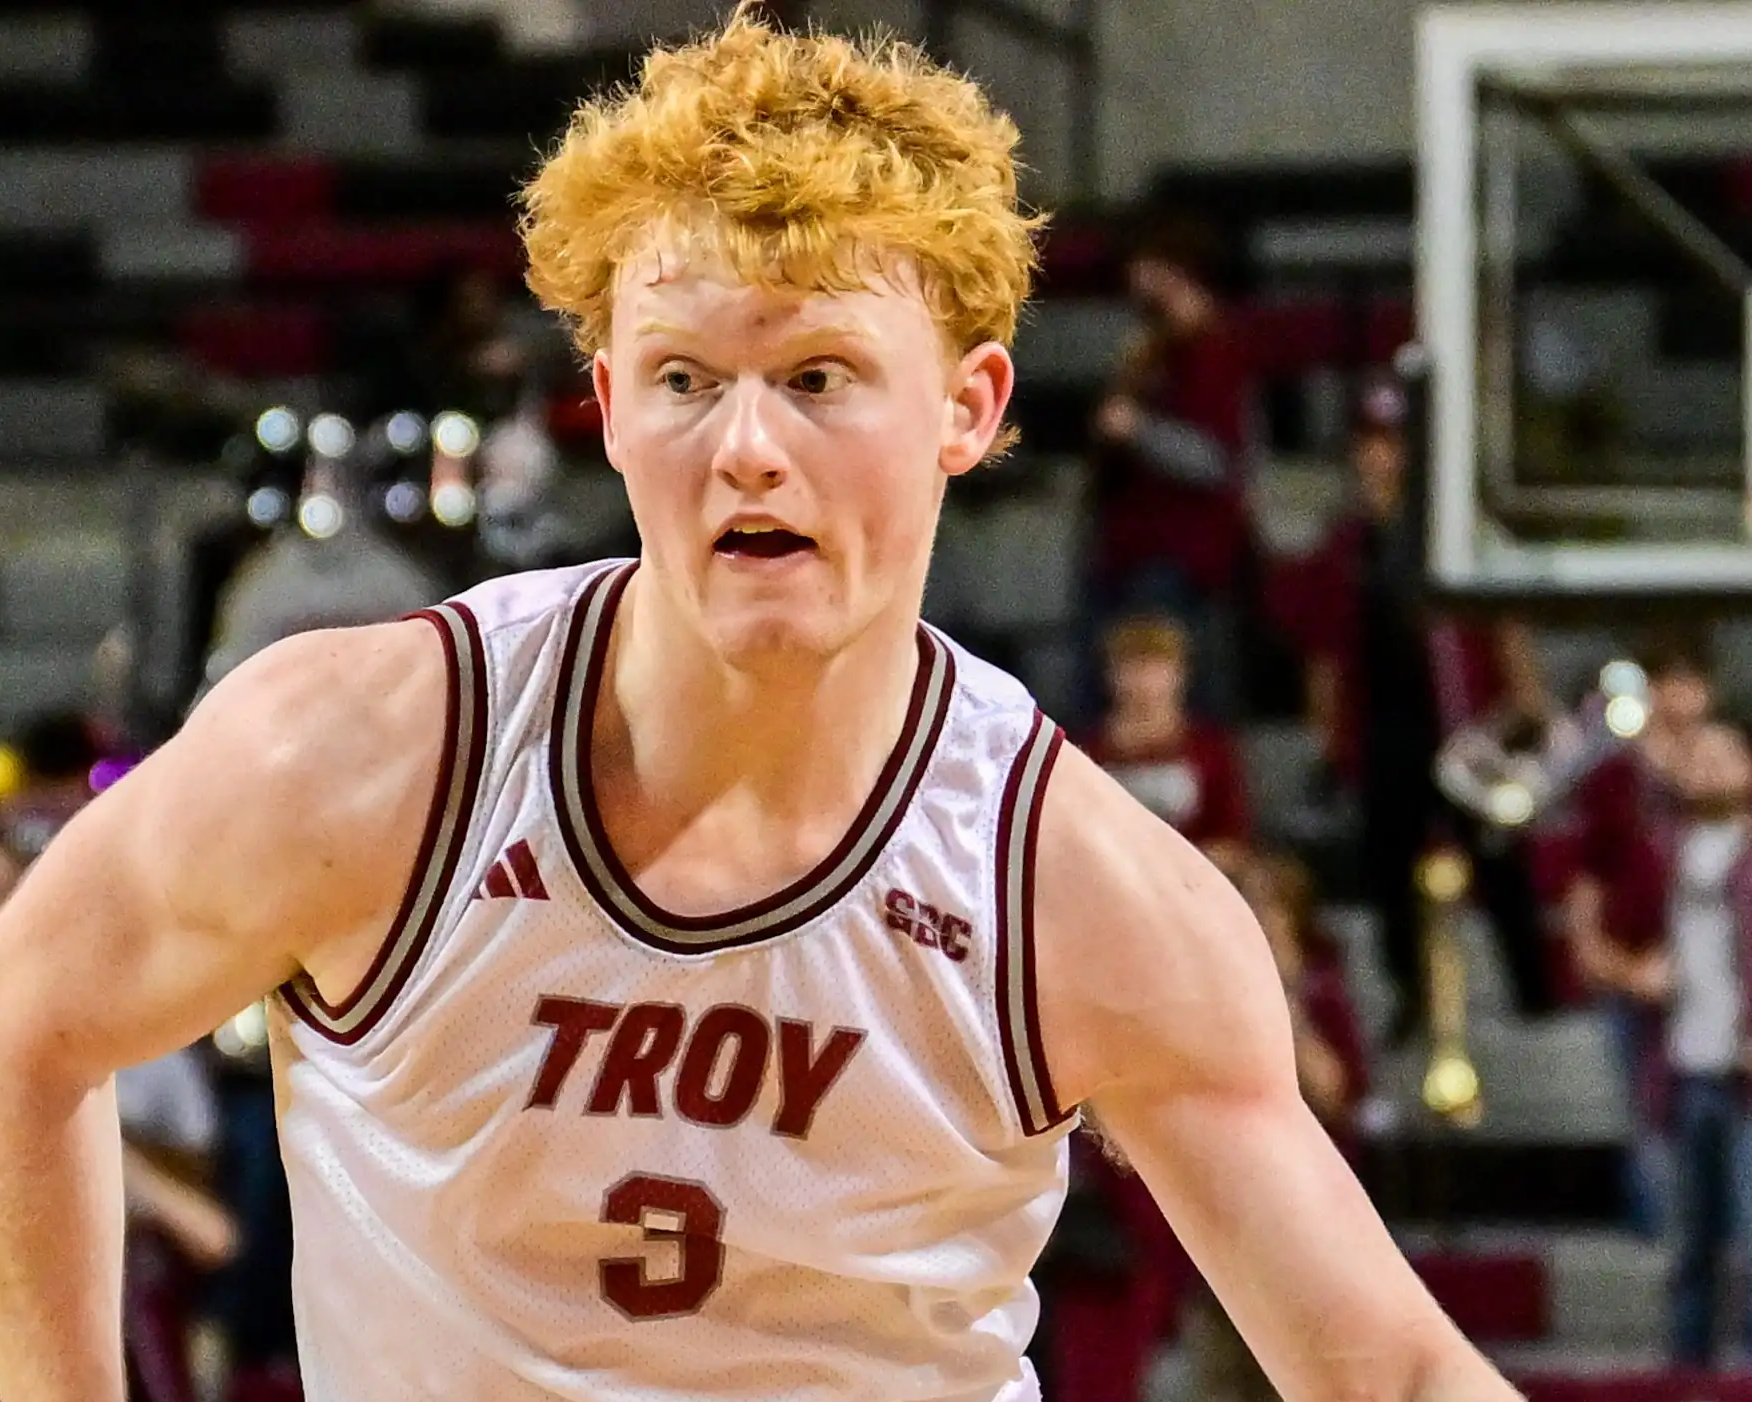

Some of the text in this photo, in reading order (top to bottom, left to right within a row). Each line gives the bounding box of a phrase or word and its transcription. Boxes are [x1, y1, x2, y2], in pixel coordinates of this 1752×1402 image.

[885, 887, 973, 964] SBC
[522, 993, 869, 1141] TROY
[598, 1170, 728, 1323] 3
